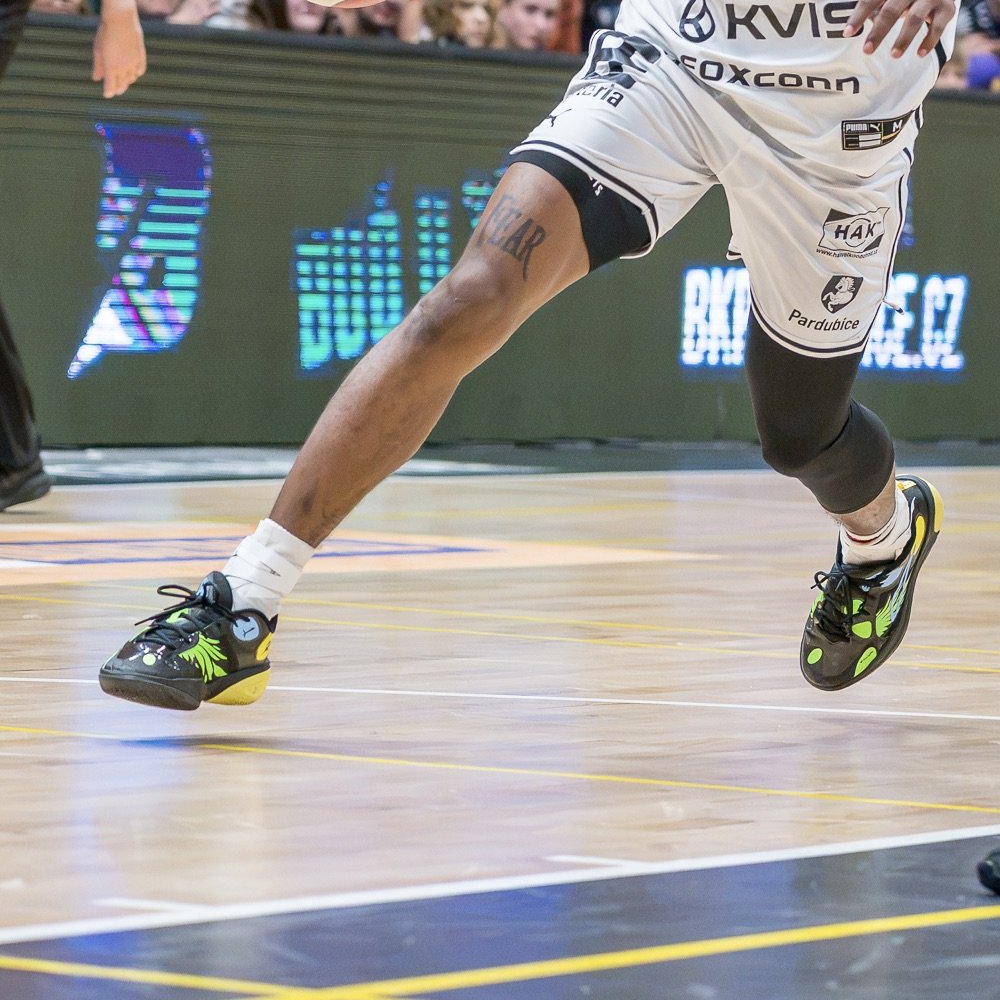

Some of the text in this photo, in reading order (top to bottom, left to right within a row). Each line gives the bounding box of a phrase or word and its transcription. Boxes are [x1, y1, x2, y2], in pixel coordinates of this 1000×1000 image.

[725, 0, 865, 40] KVIS
[576, 84, 624, 108] eria
[834, 222, 877, 242] HAK
[787, 308, 860, 332] Pardubice
